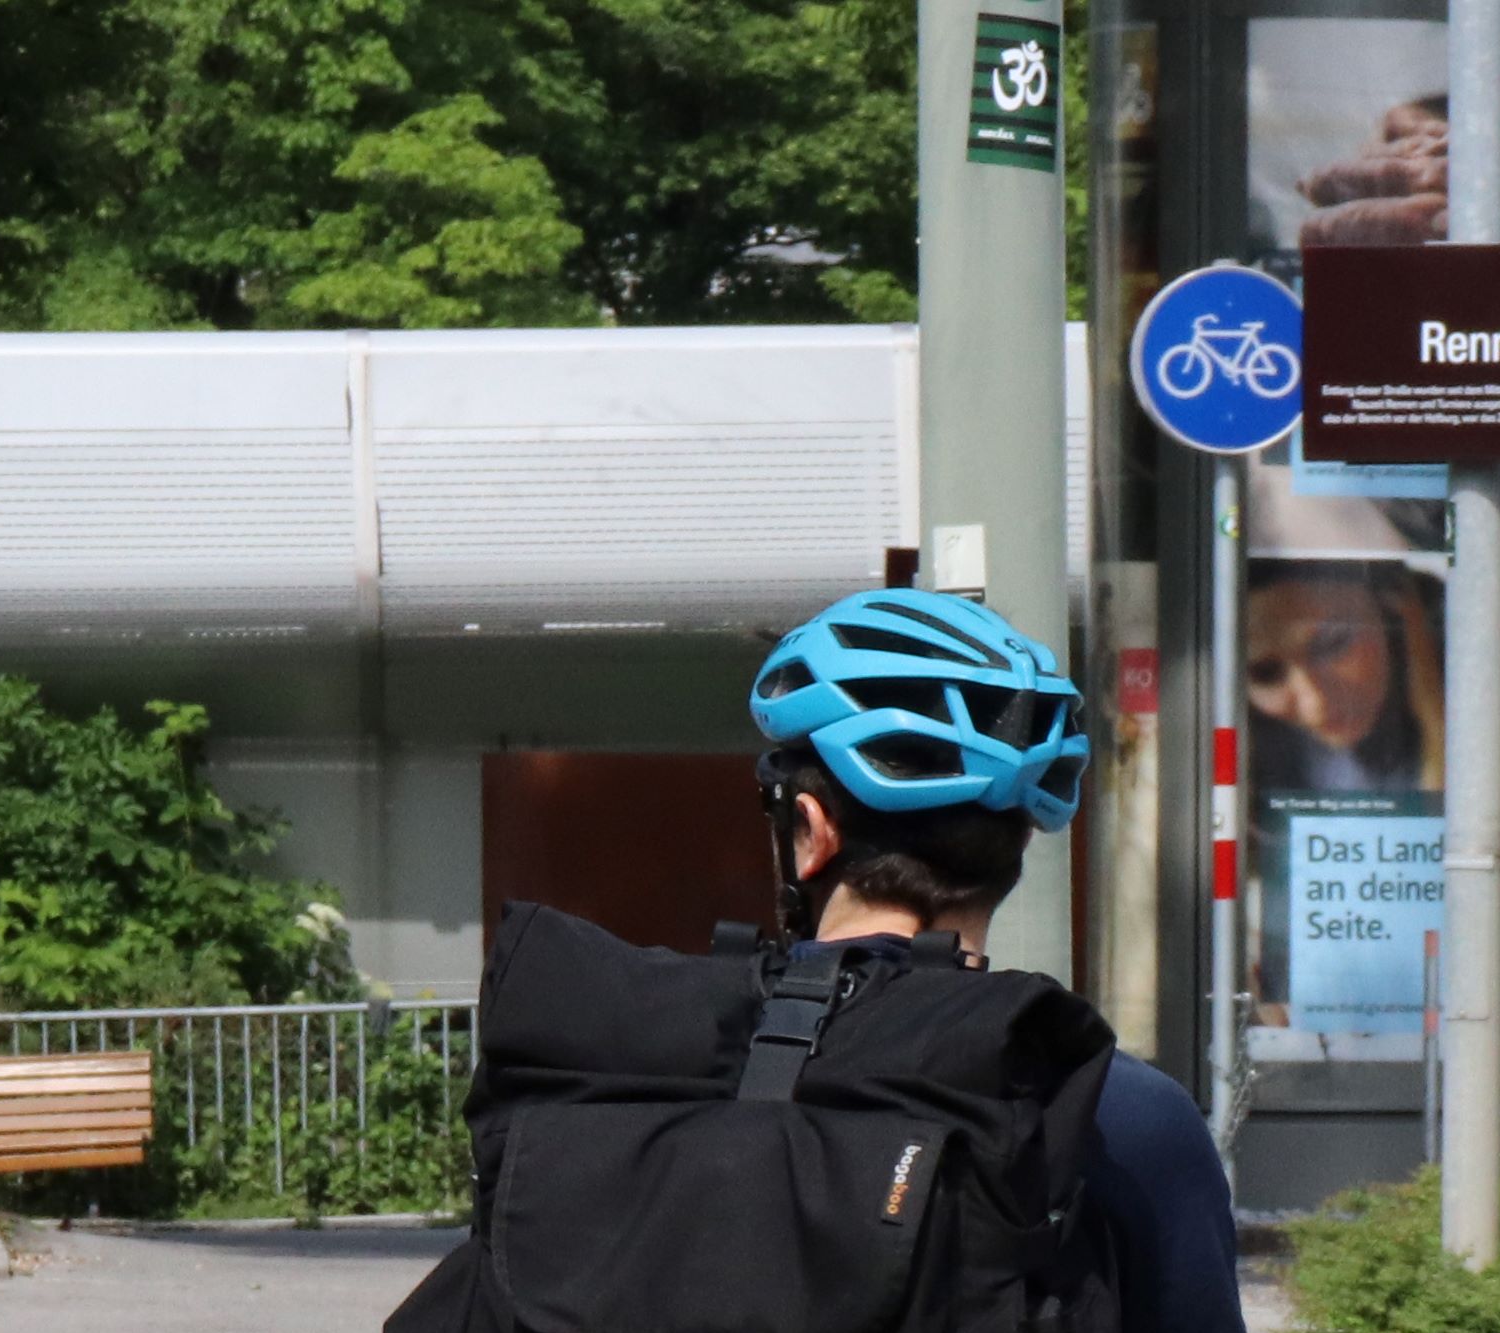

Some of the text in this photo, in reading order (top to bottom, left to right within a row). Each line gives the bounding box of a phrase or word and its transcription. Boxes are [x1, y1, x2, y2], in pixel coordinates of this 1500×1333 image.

[1307, 832, 1446, 863] Das Land
[1307, 879, 1346, 901] an
[1307, 910, 1393, 940] Seite.
[886, 1144, 923, 1215] bagaboo
